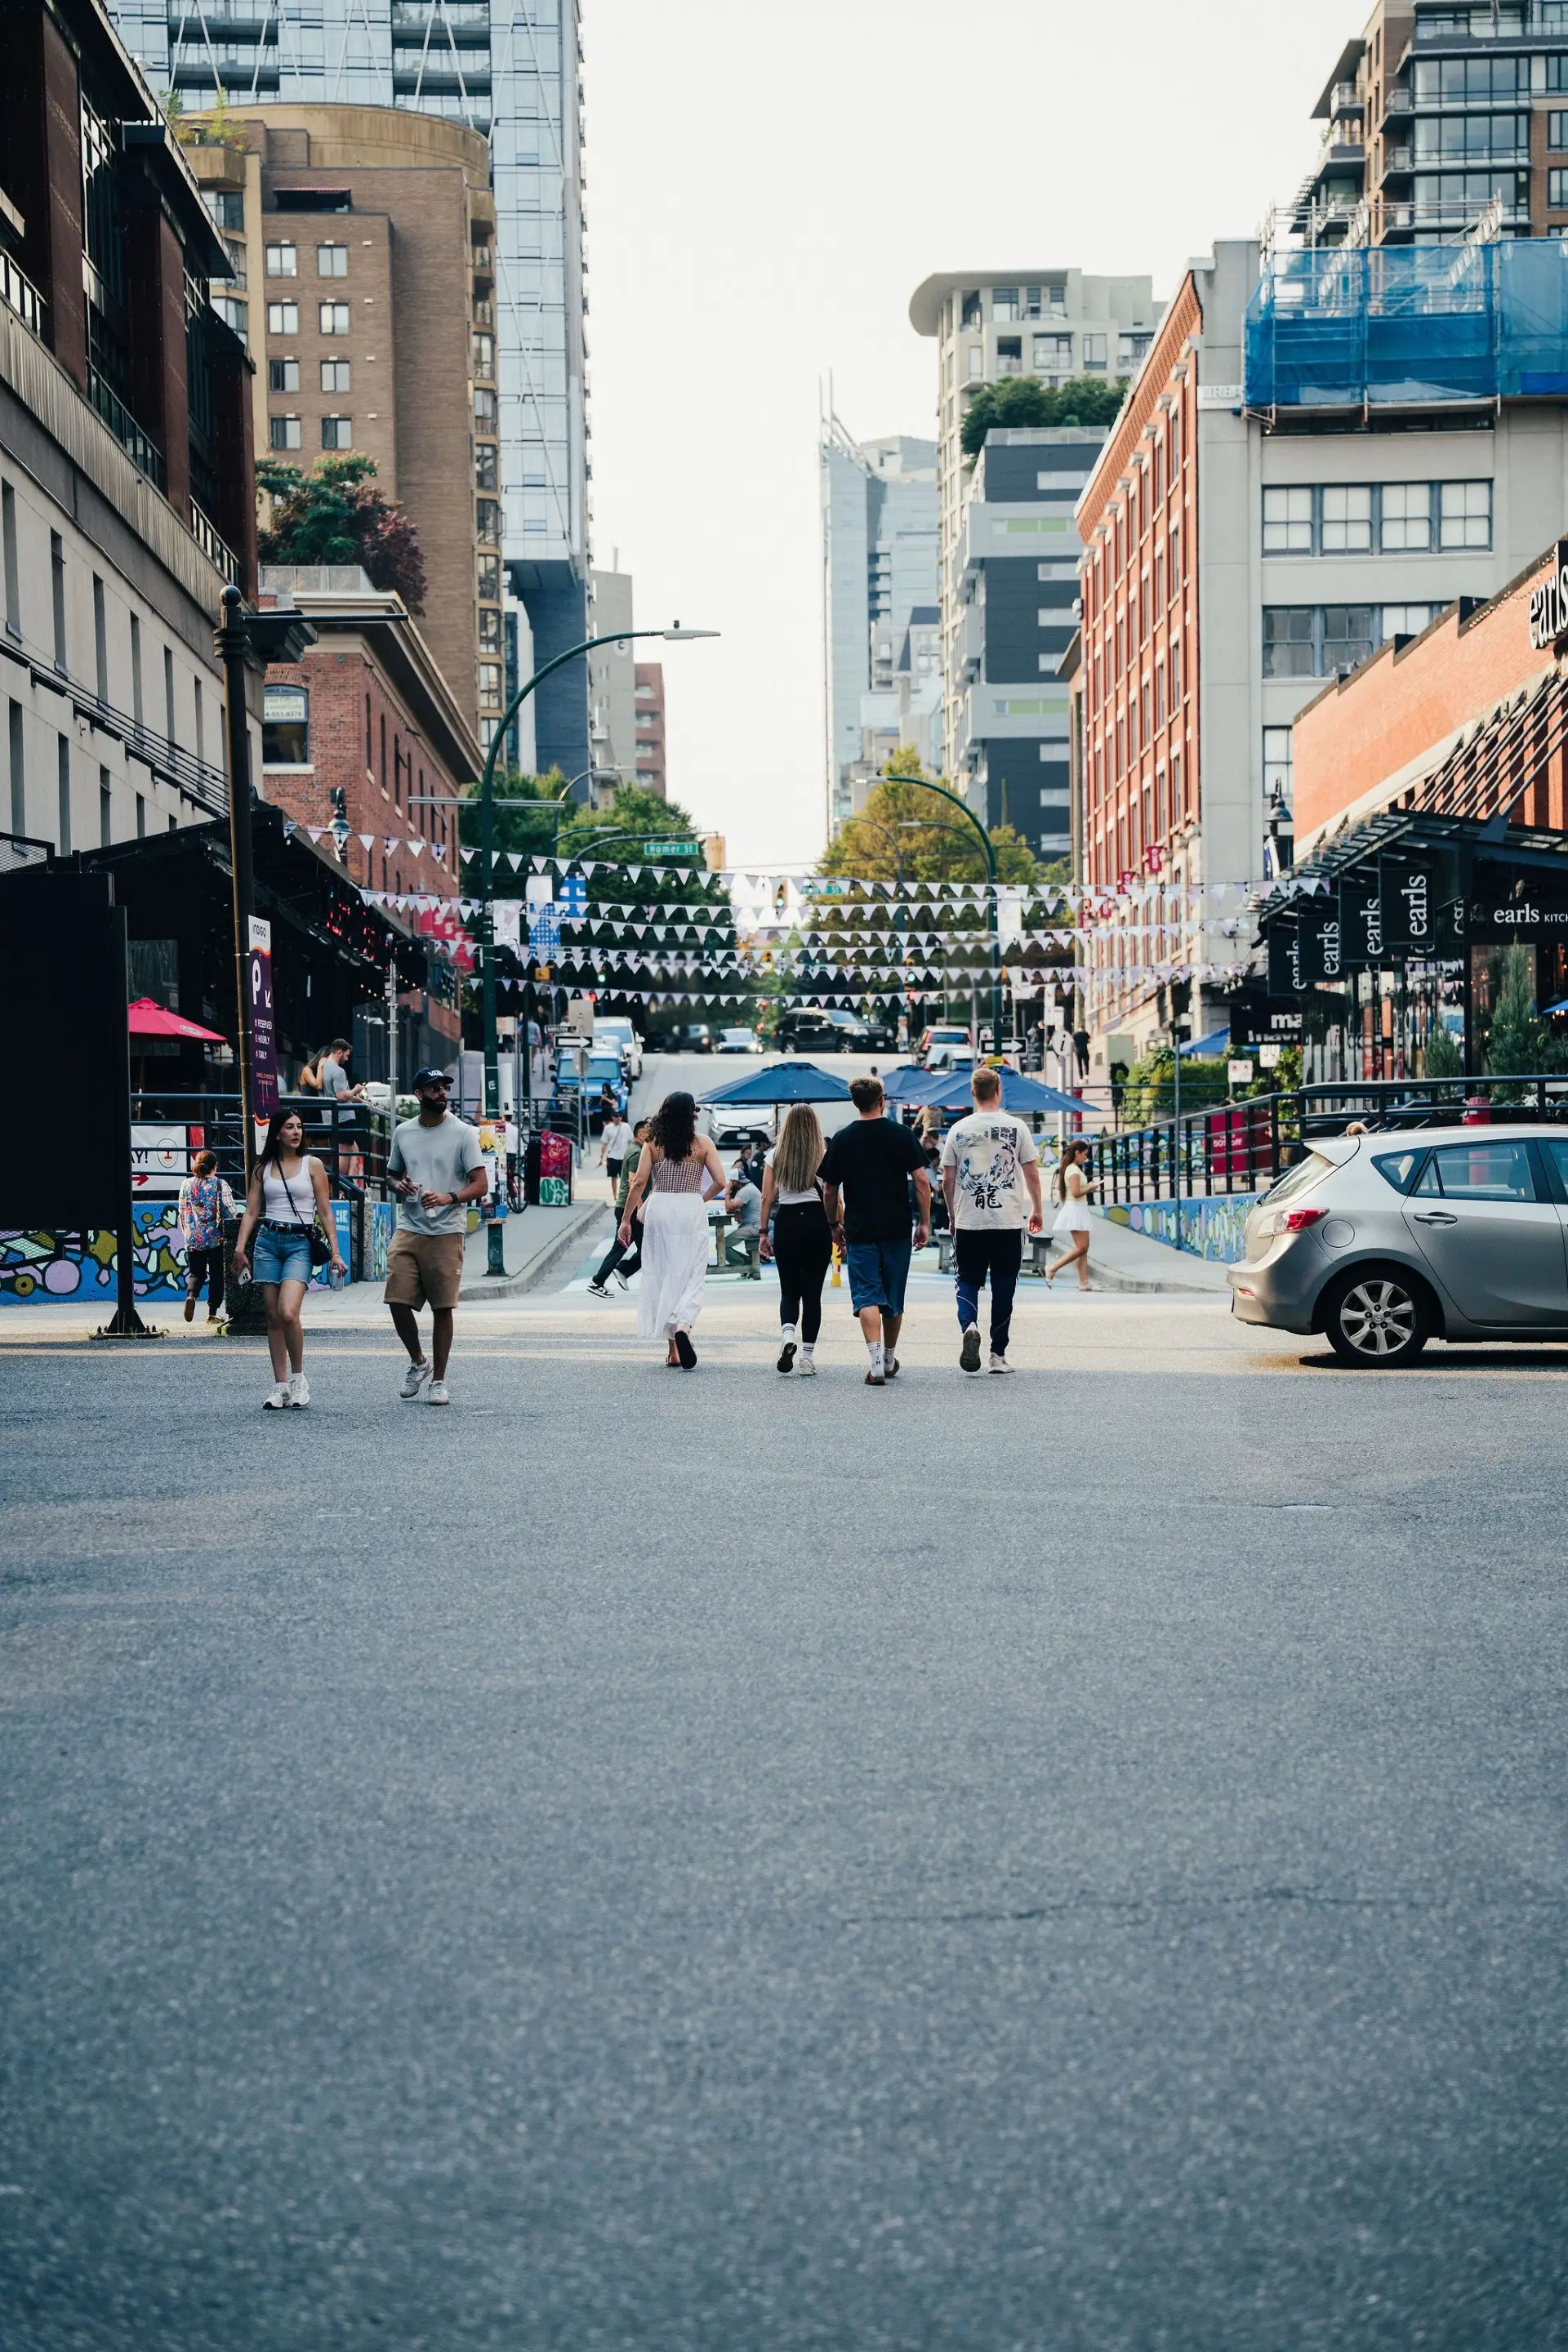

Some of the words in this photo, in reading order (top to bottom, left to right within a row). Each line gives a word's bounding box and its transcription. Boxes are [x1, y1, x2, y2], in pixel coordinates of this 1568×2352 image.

[649, 845, 680, 853] Homer
[684, 844, 693, 853] St
[1360, 898, 1383, 956] earls
[1401, 875, 1428, 936] earls
[1494, 902, 1540, 924] earls
[1316, 921, 1339, 975] earls
